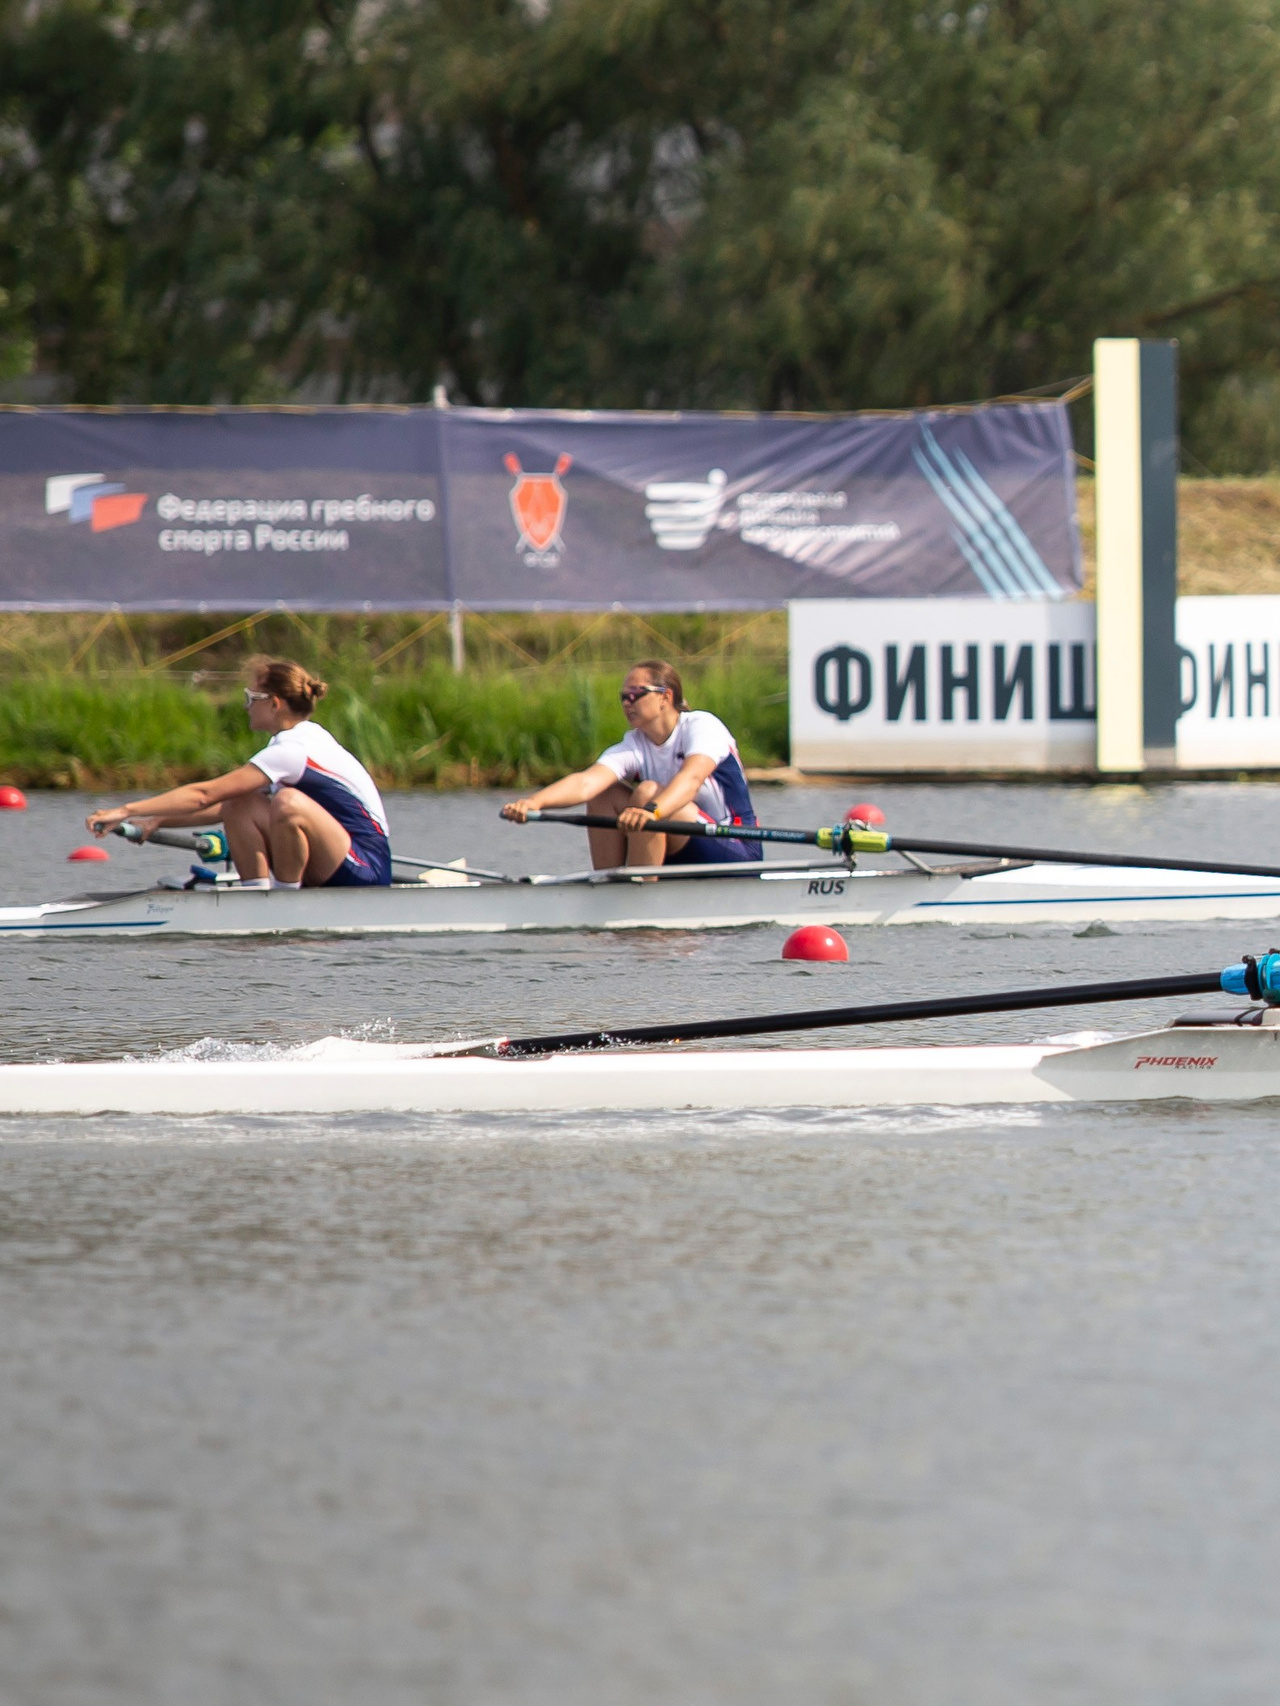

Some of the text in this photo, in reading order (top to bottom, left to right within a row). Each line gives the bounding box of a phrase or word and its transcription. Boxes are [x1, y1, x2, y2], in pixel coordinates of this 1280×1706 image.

[157, 493, 436, 527] Федерация гребного
[158, 524, 350, 557] спорта России
[813, 644, 1097, 721] ФИНИШ
[808, 879, 845, 895] RUS
[1134, 1056, 1219, 1070] PHOENIX
